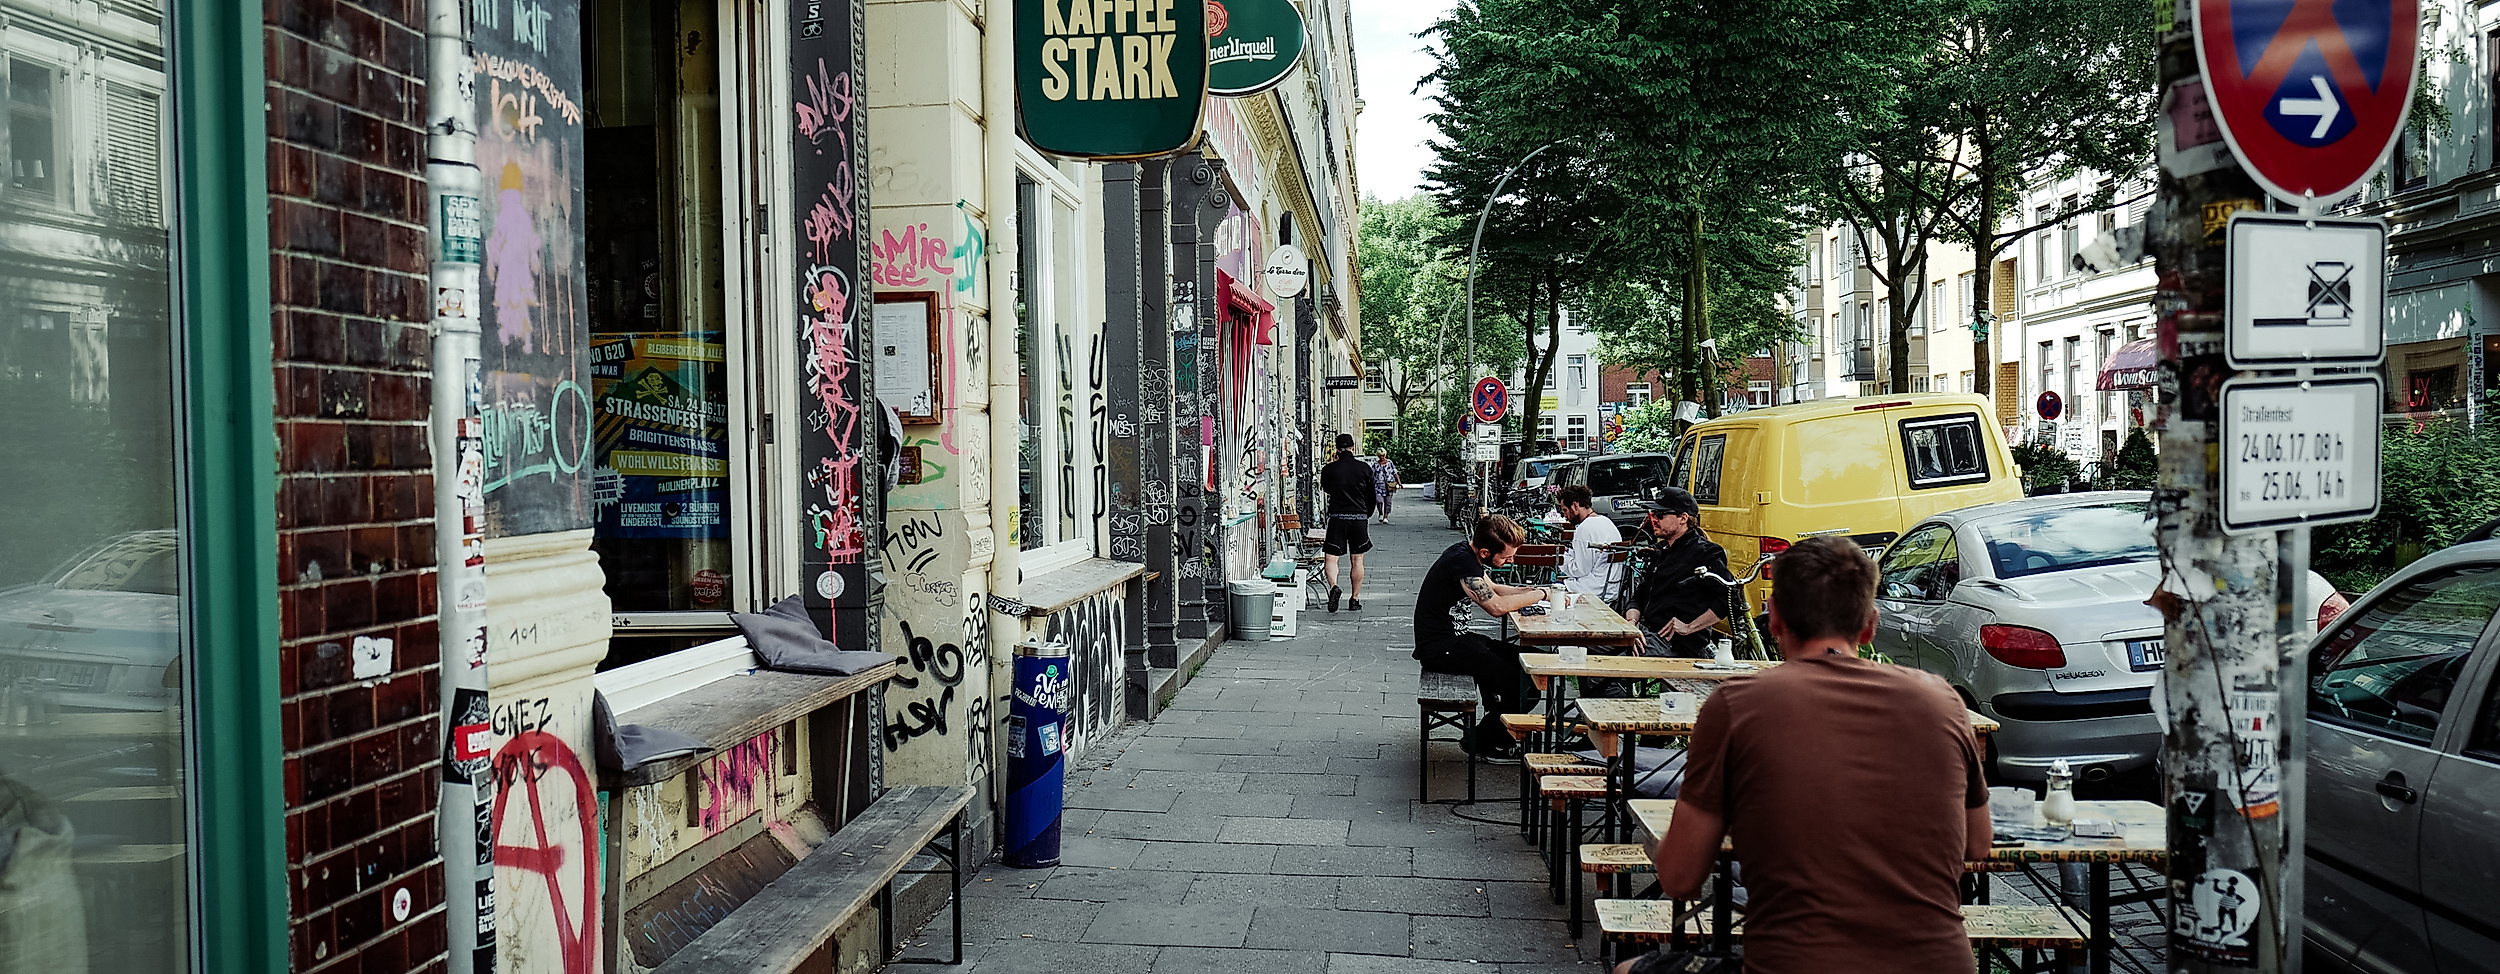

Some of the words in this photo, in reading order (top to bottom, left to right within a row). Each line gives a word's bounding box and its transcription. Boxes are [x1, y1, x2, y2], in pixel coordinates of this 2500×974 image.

[1043, 0, 1176, 35] KAFFEE
[1229, 37, 1275, 61] Urquell
[1041, 35, 1179, 101] STARK
[604, 343, 625, 360] G20
[647, 343, 690, 355] BLEIBERECHT
[706, 349, 723, 359] ALLE
[601, 365, 618, 376] WAR
[668, 395, 684, 411] SA,
[605, 397, 706, 430] STRASSENFEST
[629, 428, 718, 453] BRIGITTENSTRASSE
[2314, 433, 2330, 461] 08
[2336, 433, 2343, 461] h
[617, 454, 720, 472] WOHLWILLSTRASSE
[658, 477, 719, 492] PAULINENPLATZ
[2318, 471, 2330, 499] 14
[2337, 471, 2344, 499] h
[620, 502, 662, 513] LIVEMUSIK
[682, 503, 688, 512] 2
[689, 500, 720, 513] BÜHNEN
[620, 517, 662, 527] KINDERFEST
[693, 586, 713, 598] yelp
[2056, 670, 2106, 680] PEUGEOT
